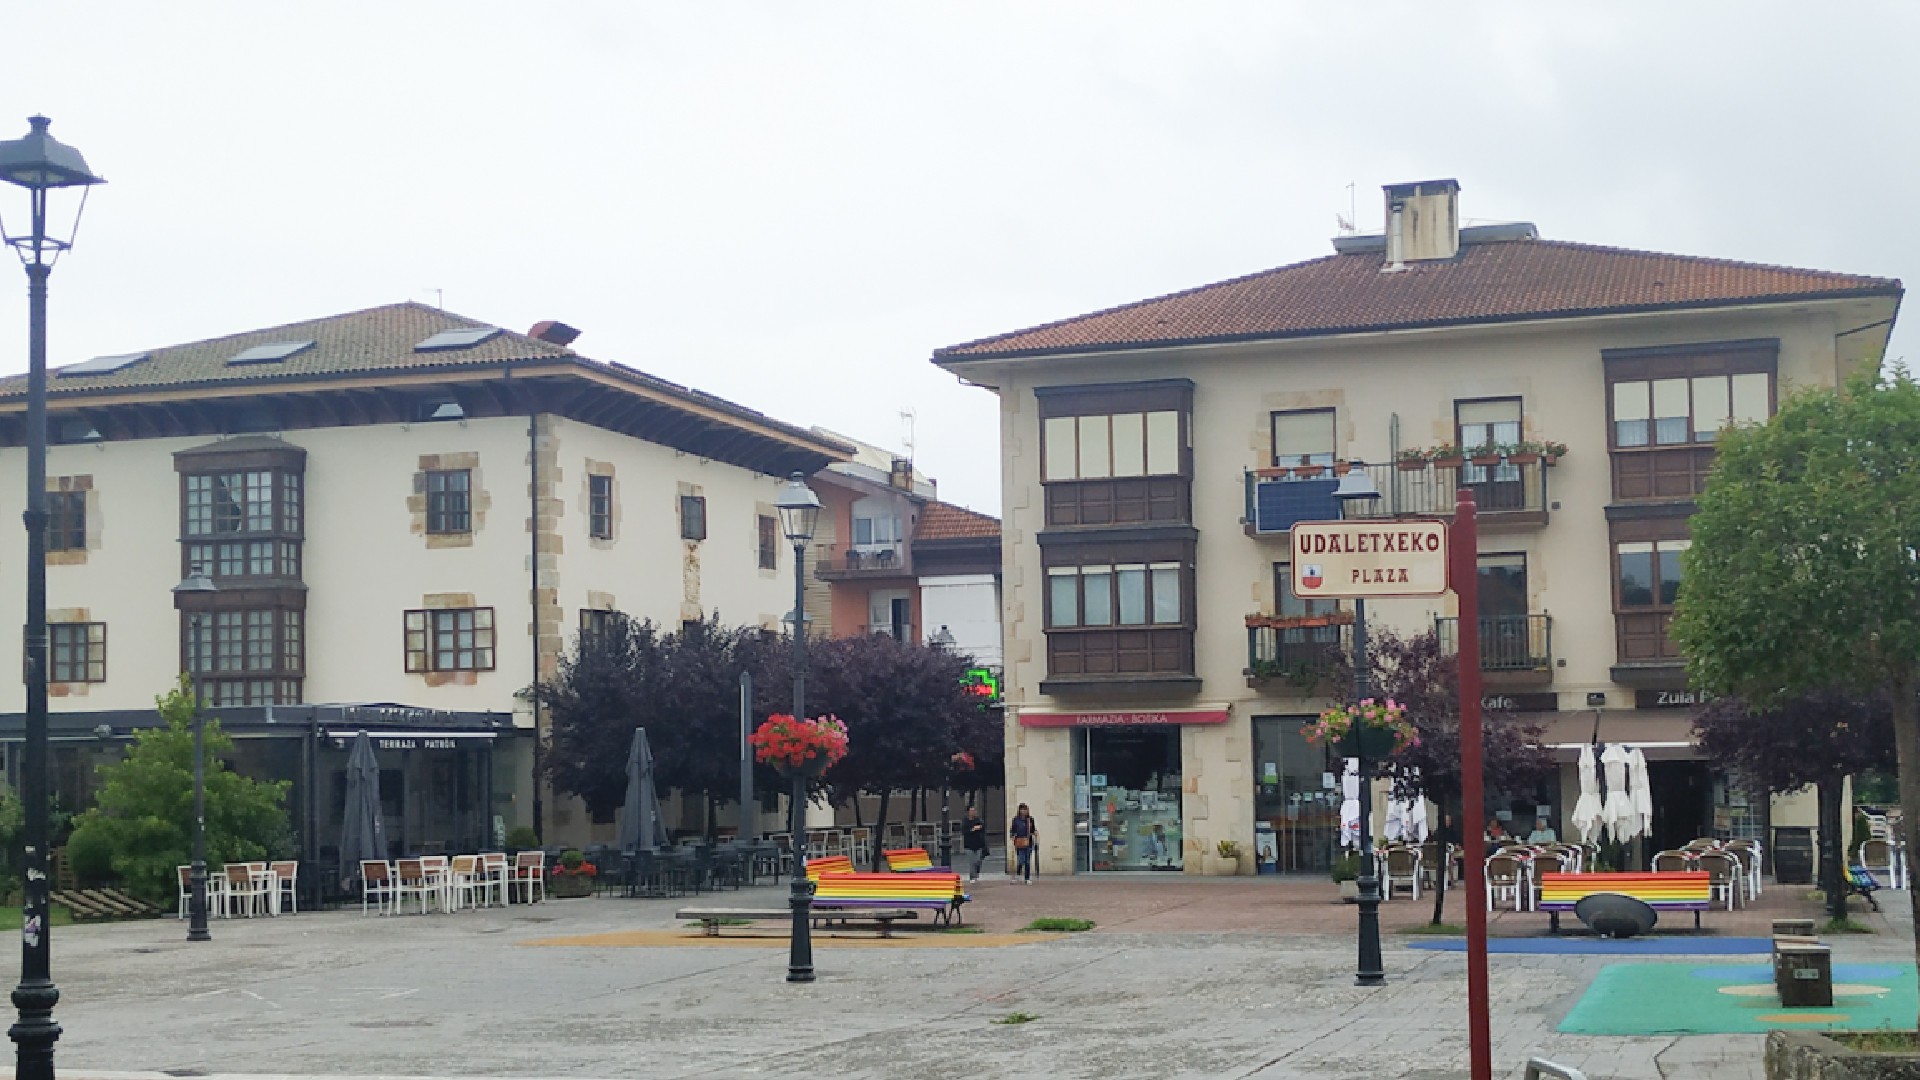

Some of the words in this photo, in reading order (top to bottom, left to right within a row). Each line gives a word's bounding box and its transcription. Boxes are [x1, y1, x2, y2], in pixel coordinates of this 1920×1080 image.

[1300, 532, 1439, 554] UDALETXEKO
[1352, 568, 1409, 584] PLAZA
[1131, 713, 1168, 724] BOTIKA
